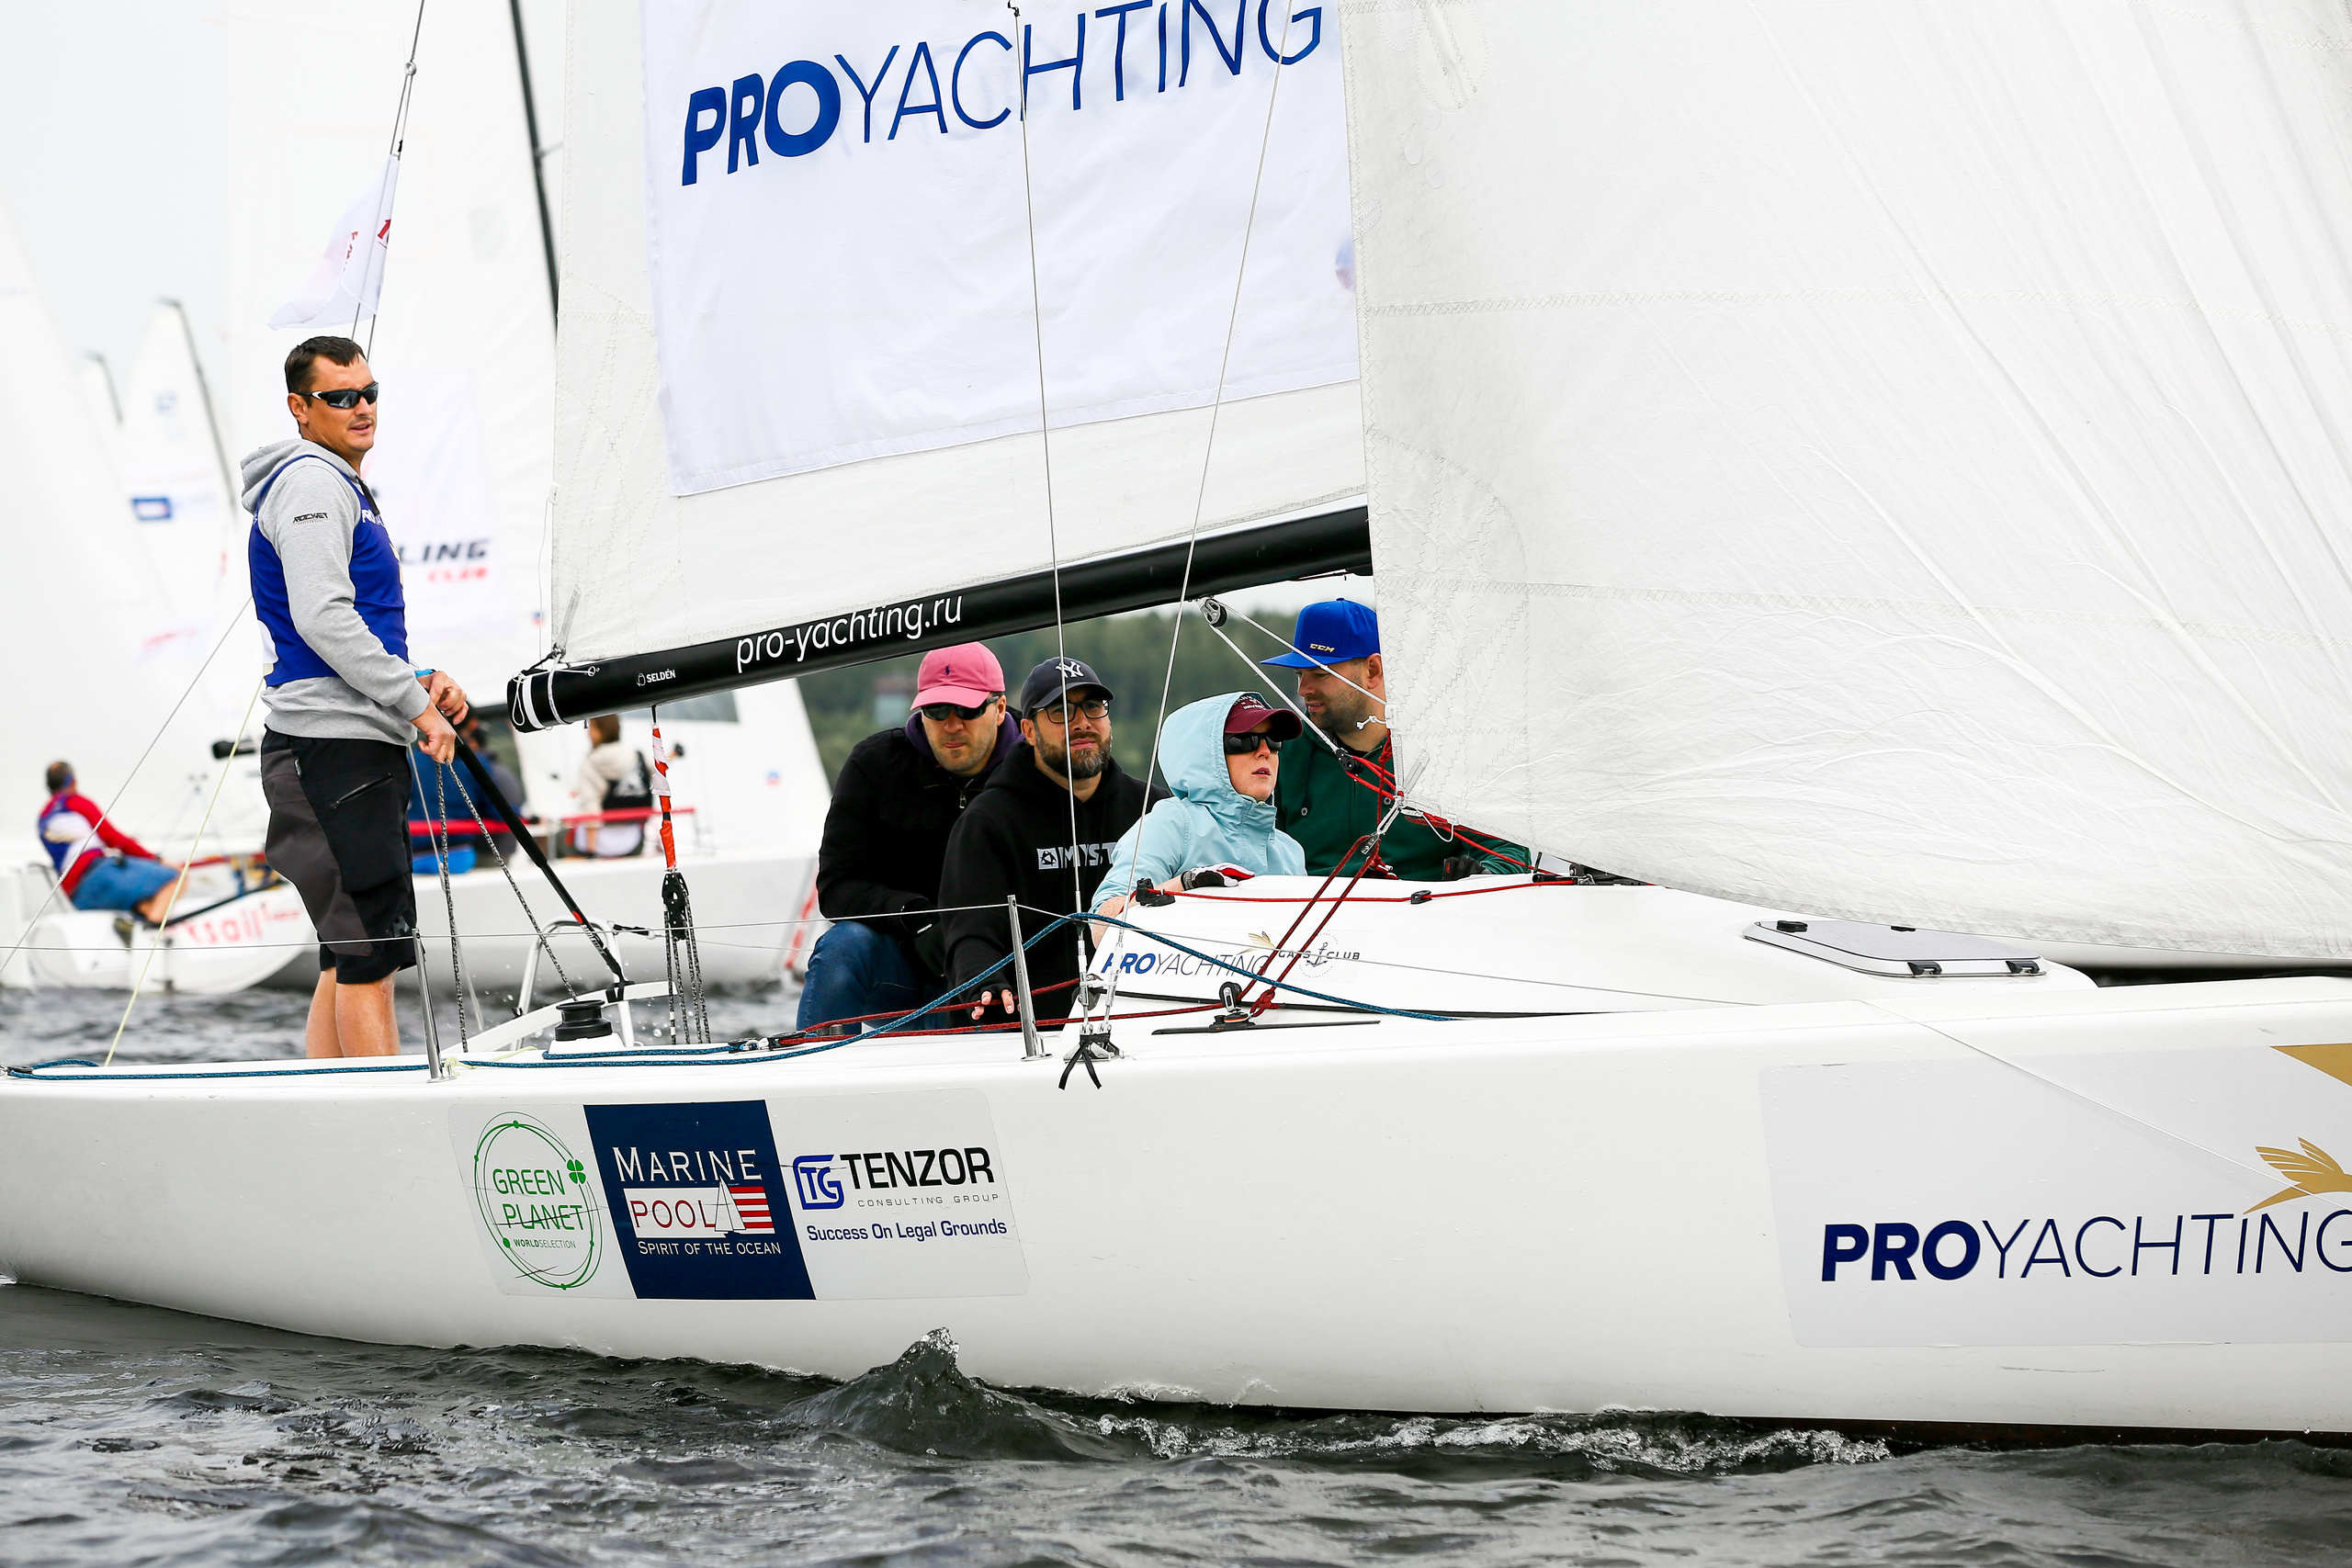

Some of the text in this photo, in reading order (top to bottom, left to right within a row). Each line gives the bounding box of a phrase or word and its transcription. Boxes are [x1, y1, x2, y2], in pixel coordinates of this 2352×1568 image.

[682, 0, 1322, 186] PROYACHTING
[736, 595, 963, 673] pro-yachting.ru
[1309, 642, 1335, 653] CCM
[646, 668, 676, 683] SELDÉN
[1057, 842, 1117, 869] MYST
[1278, 949, 1360, 961] GAS CLUB
[492, 1168, 566, 1196] GREEN
[840, 1147, 995, 1190] TENZOR
[629, 1200, 716, 1228] POOL
[857, 1193, 1000, 1208] CONSULTING GROUP
[503, 1203, 585, 1232] PLANET
[807, 1218, 1007, 1242] Success On Legal Grounds
[513, 1238, 577, 1249] WORLDSELECTION
[684, 1243, 702, 1255] OF
[705, 1243, 734, 1255] THE
[736, 1242, 781, 1255] OCEAN
[1822, 1210, 2352, 1282] PROYACHTING
